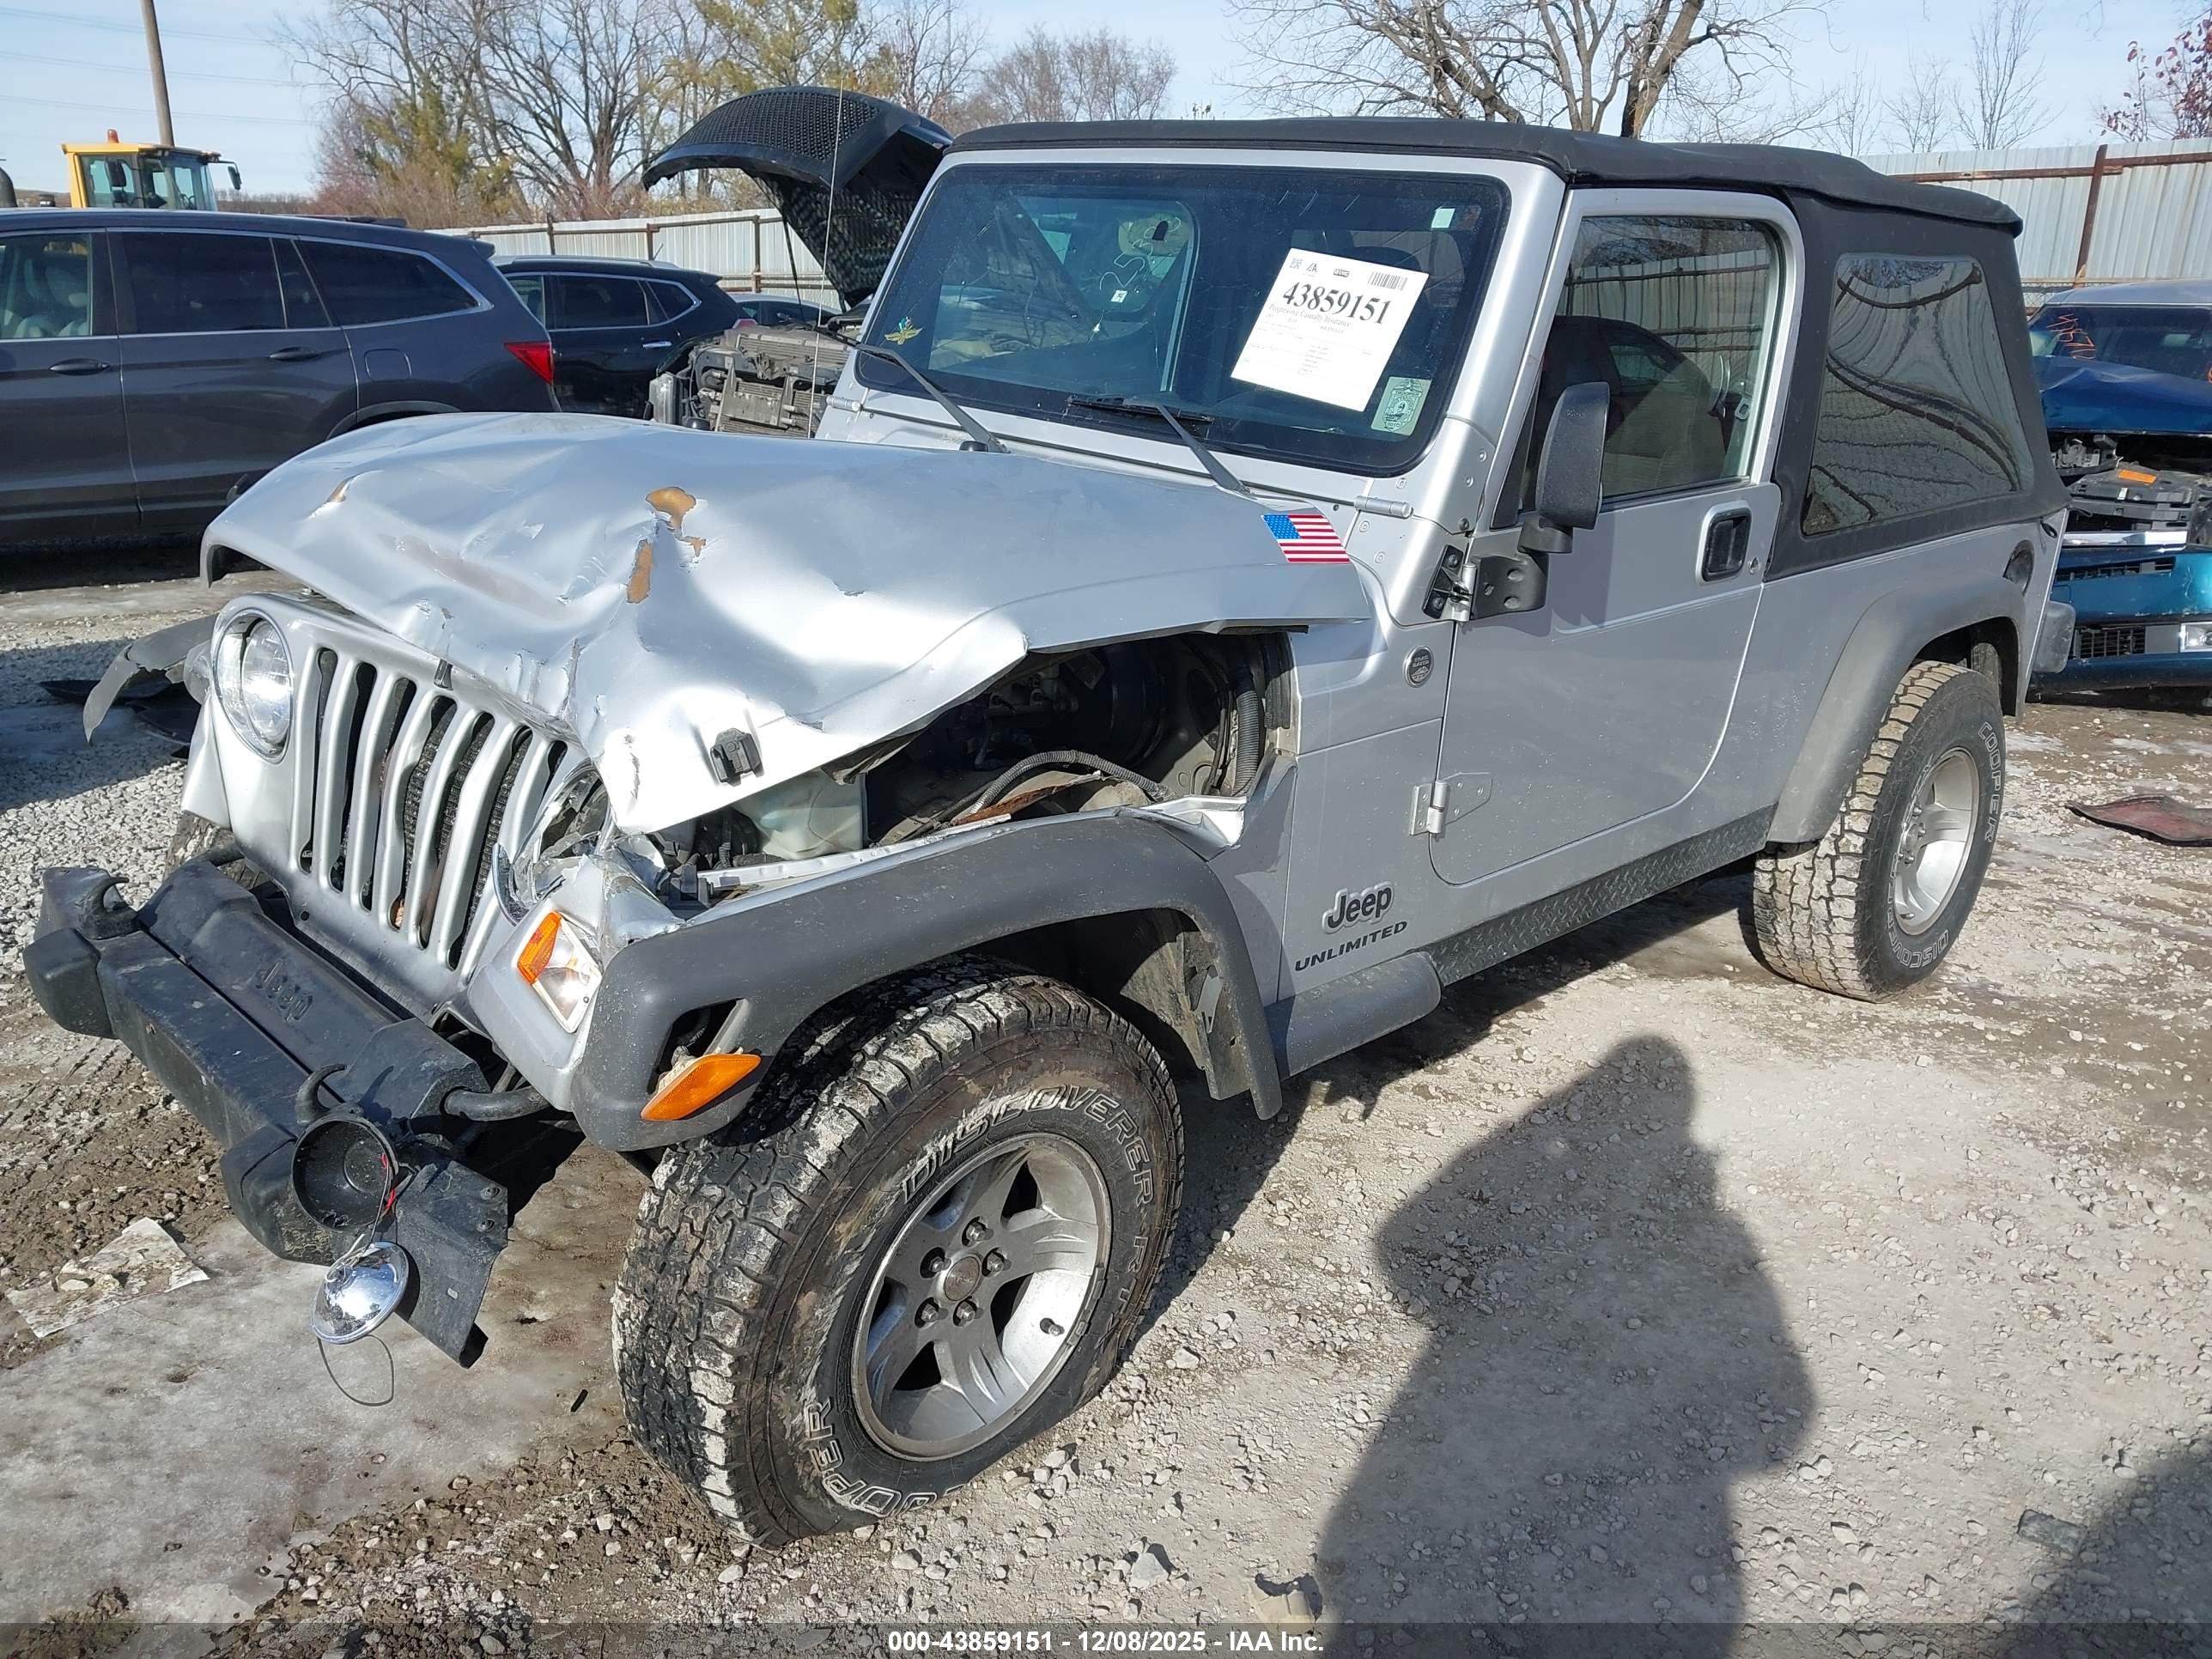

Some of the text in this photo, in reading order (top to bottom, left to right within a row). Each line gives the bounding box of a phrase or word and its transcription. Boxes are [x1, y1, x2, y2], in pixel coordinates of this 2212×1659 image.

[1283, 282, 1393, 325] 43859151
[1978, 720, 2002, 842] COOPER
[1326, 884, 1394, 931] Jeep
[1294, 921, 1408, 972] UNLIMITED
[255, 957, 313, 1023] Jeep
[902, 1085, 1154, 1208] DISCOVERER
